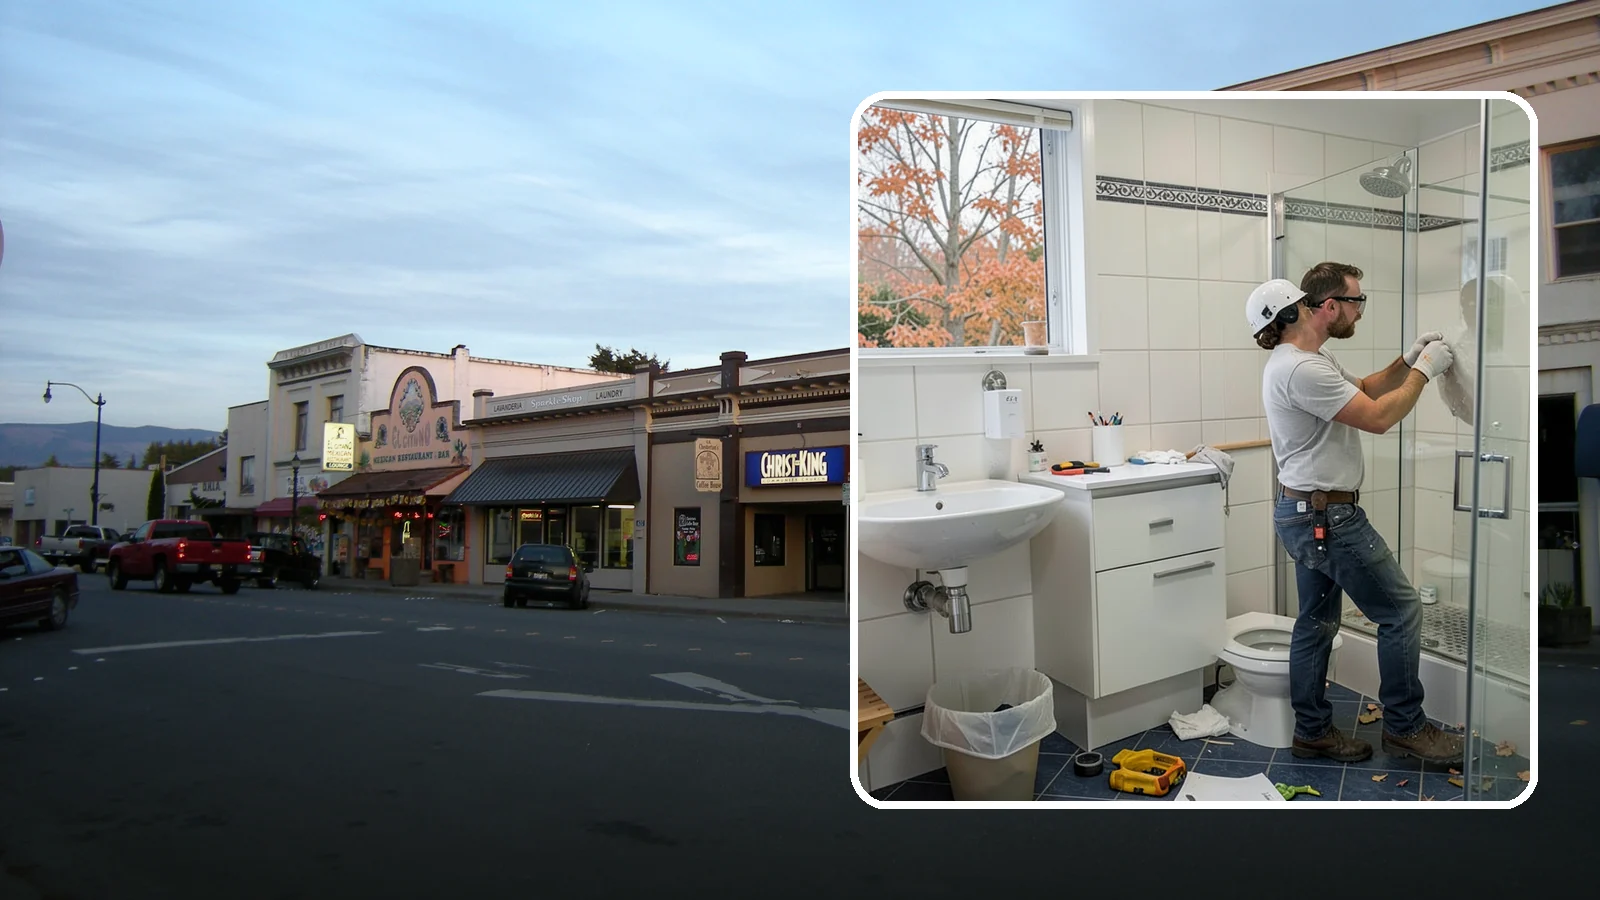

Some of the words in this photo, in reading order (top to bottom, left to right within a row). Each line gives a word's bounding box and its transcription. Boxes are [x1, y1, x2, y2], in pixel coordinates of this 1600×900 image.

[493, 401, 523, 413] LAVANDERIA
[595, 389, 624, 400] LAUNDRY
[373, 454, 396, 464] MEXICAN
[397, 451, 433, 462] RESTAURANT
[437, 450, 450, 459] BAR
[761, 452, 797, 478] CHRIST
[799, 450, 827, 476] KING
[697, 481, 709, 489] Coffee
[710, 481, 722, 489] House
